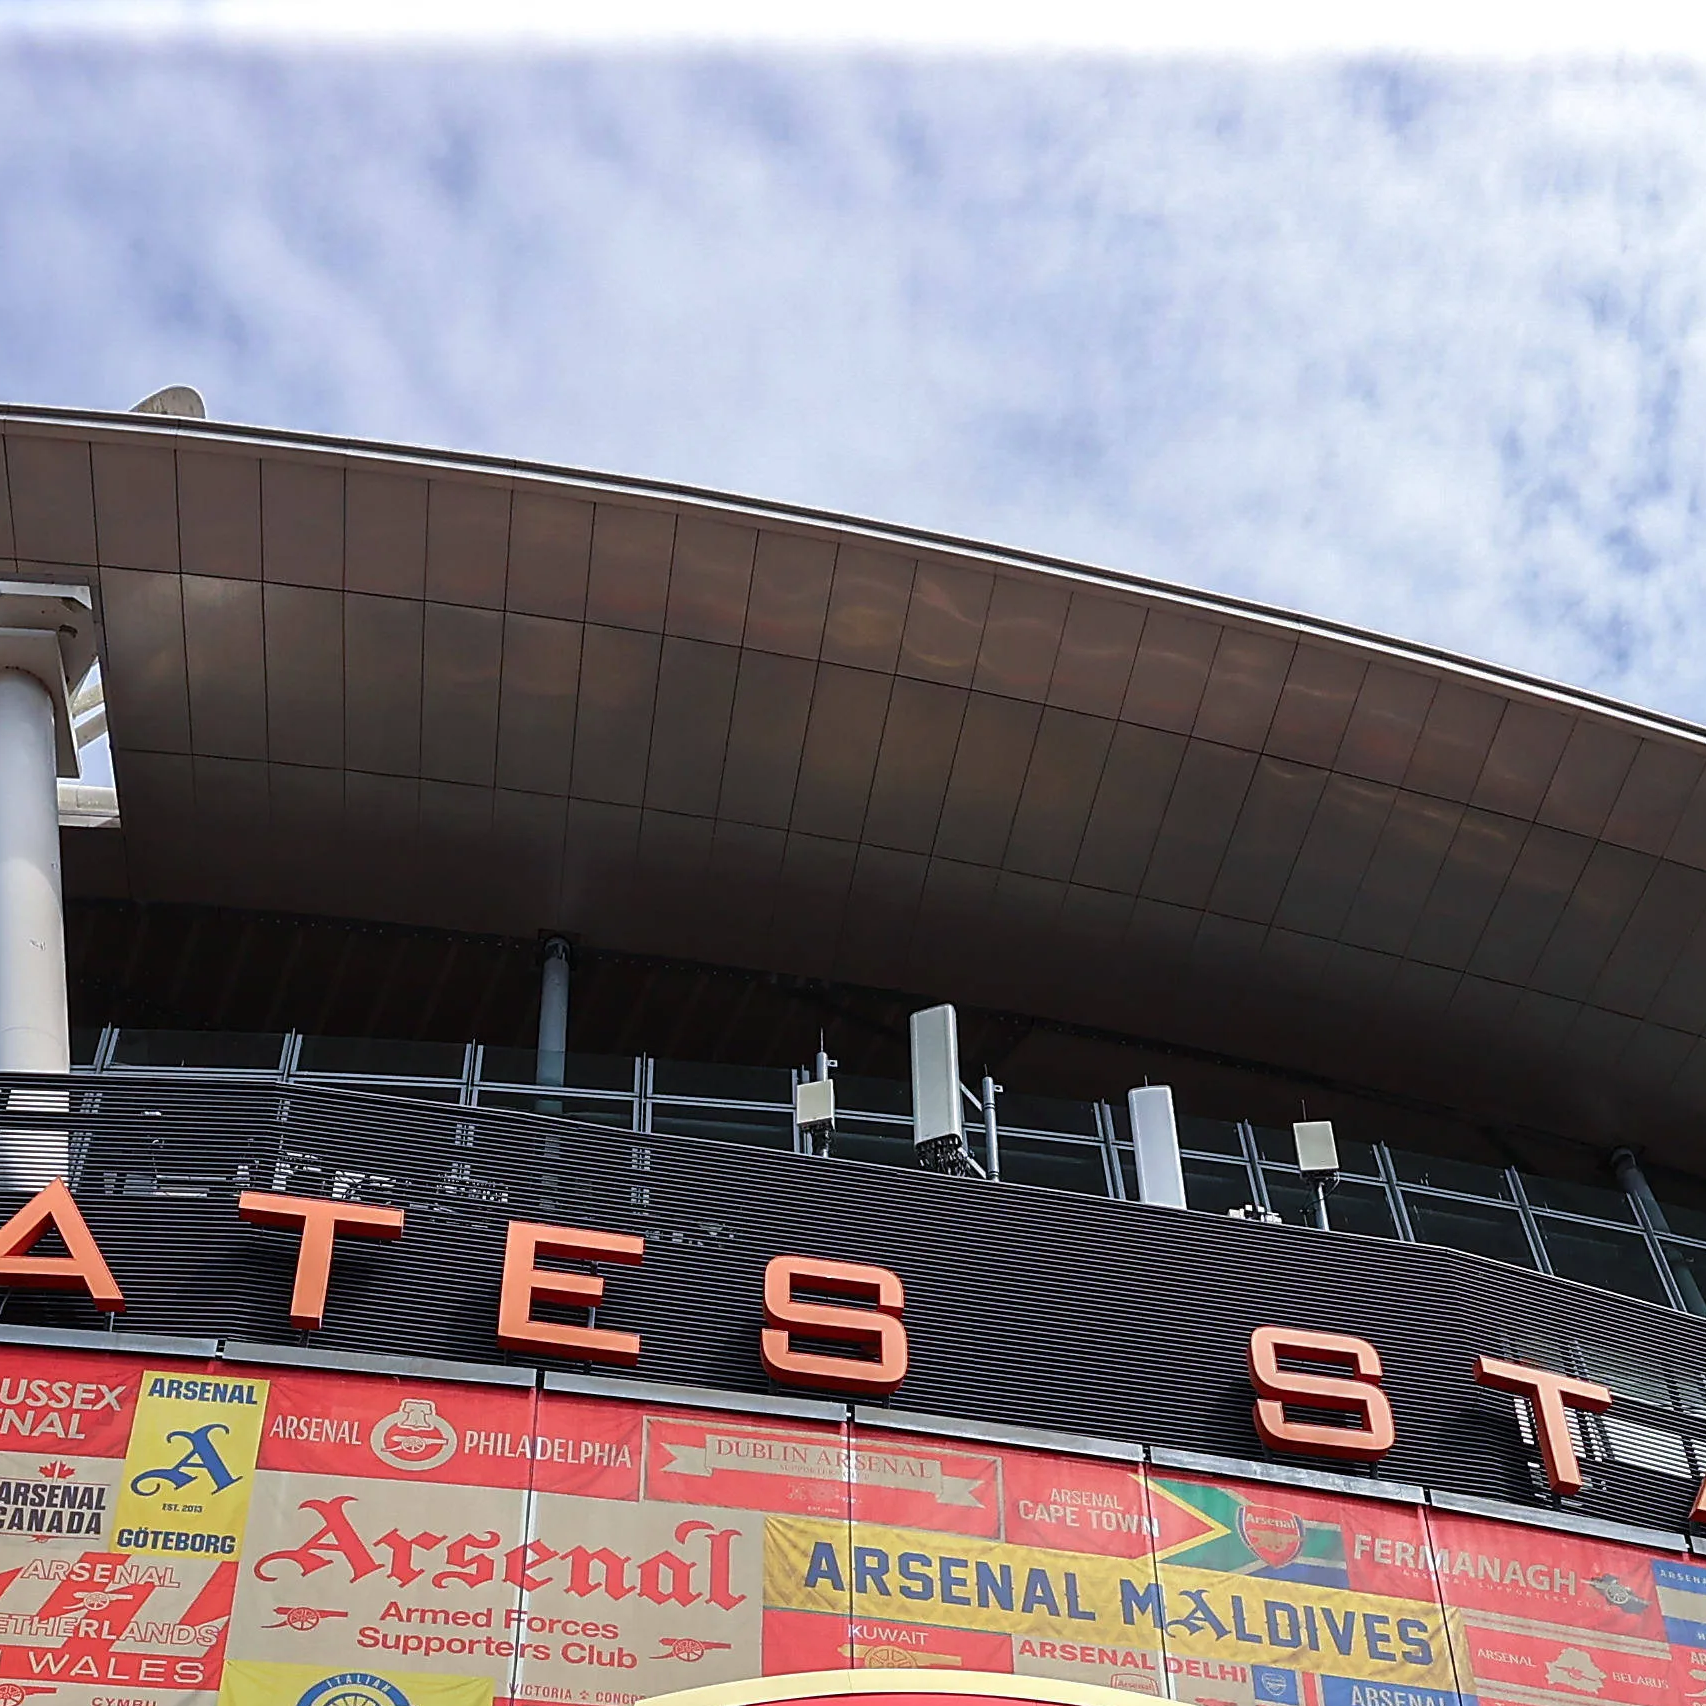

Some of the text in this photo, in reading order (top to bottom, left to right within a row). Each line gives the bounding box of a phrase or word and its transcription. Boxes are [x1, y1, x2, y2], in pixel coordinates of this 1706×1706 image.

[269, 1415, 634, 1469] ARSENAL PHILADELPHIA
[1019, 1500, 1160, 1539] CAPE TOWN
[115, 1527, 238, 1556] GÖTEBORG
[253, 1495, 748, 1612] Arsenal
[805, 1541, 1437, 1666] ARSENAL MALDIVES
[847, 1622, 929, 1645] KUWAIT
[27, 1653, 206, 1685] WALES
[1613, 1672, 1669, 1690] BELARUS
